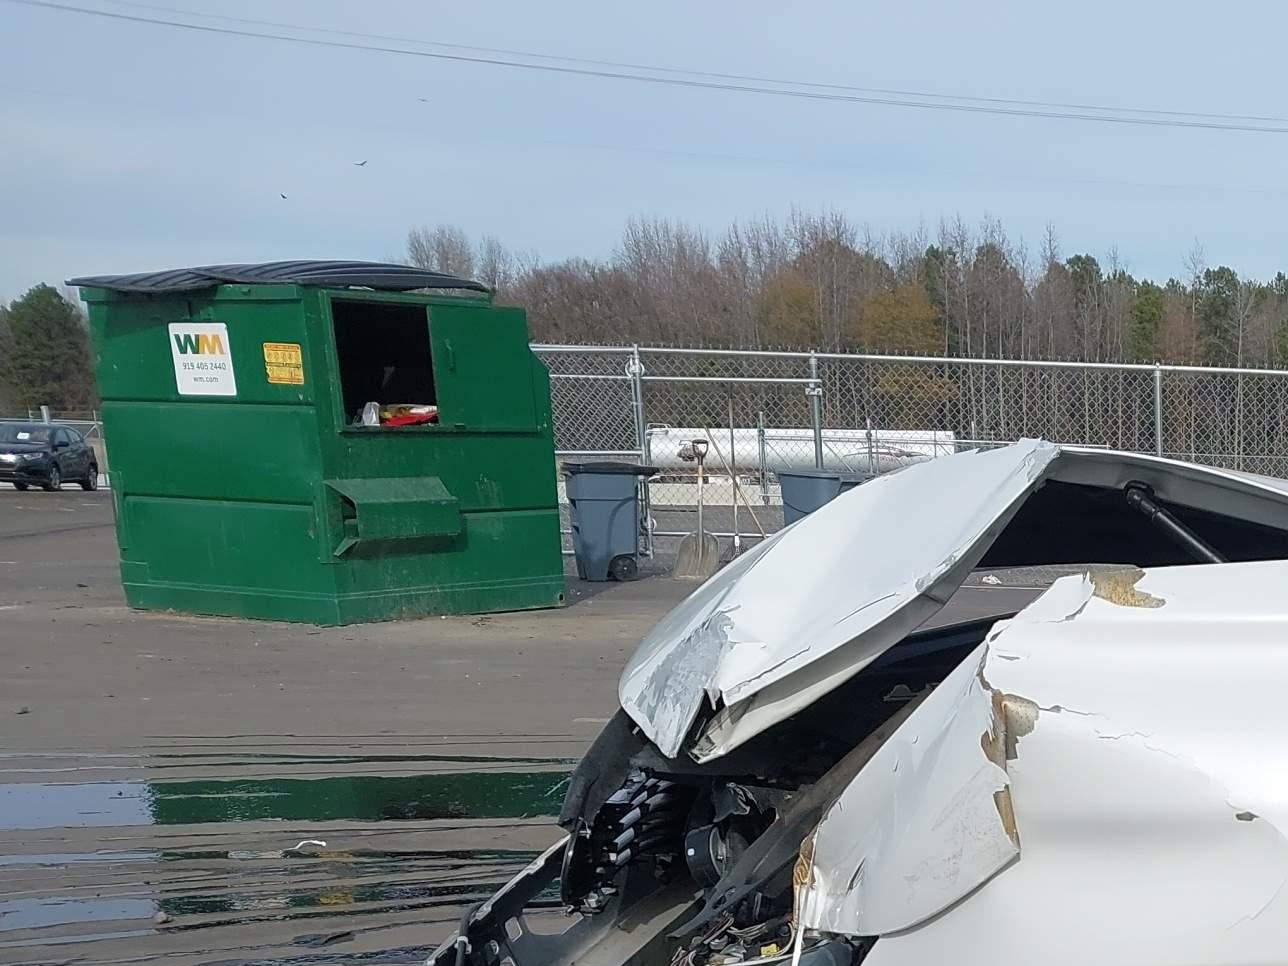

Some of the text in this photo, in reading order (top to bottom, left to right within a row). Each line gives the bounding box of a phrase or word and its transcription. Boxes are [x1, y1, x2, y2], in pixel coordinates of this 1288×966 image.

[174, 334, 225, 354] WM
[196, 362, 209, 371] 405
[210, 362, 227, 371] 2440
